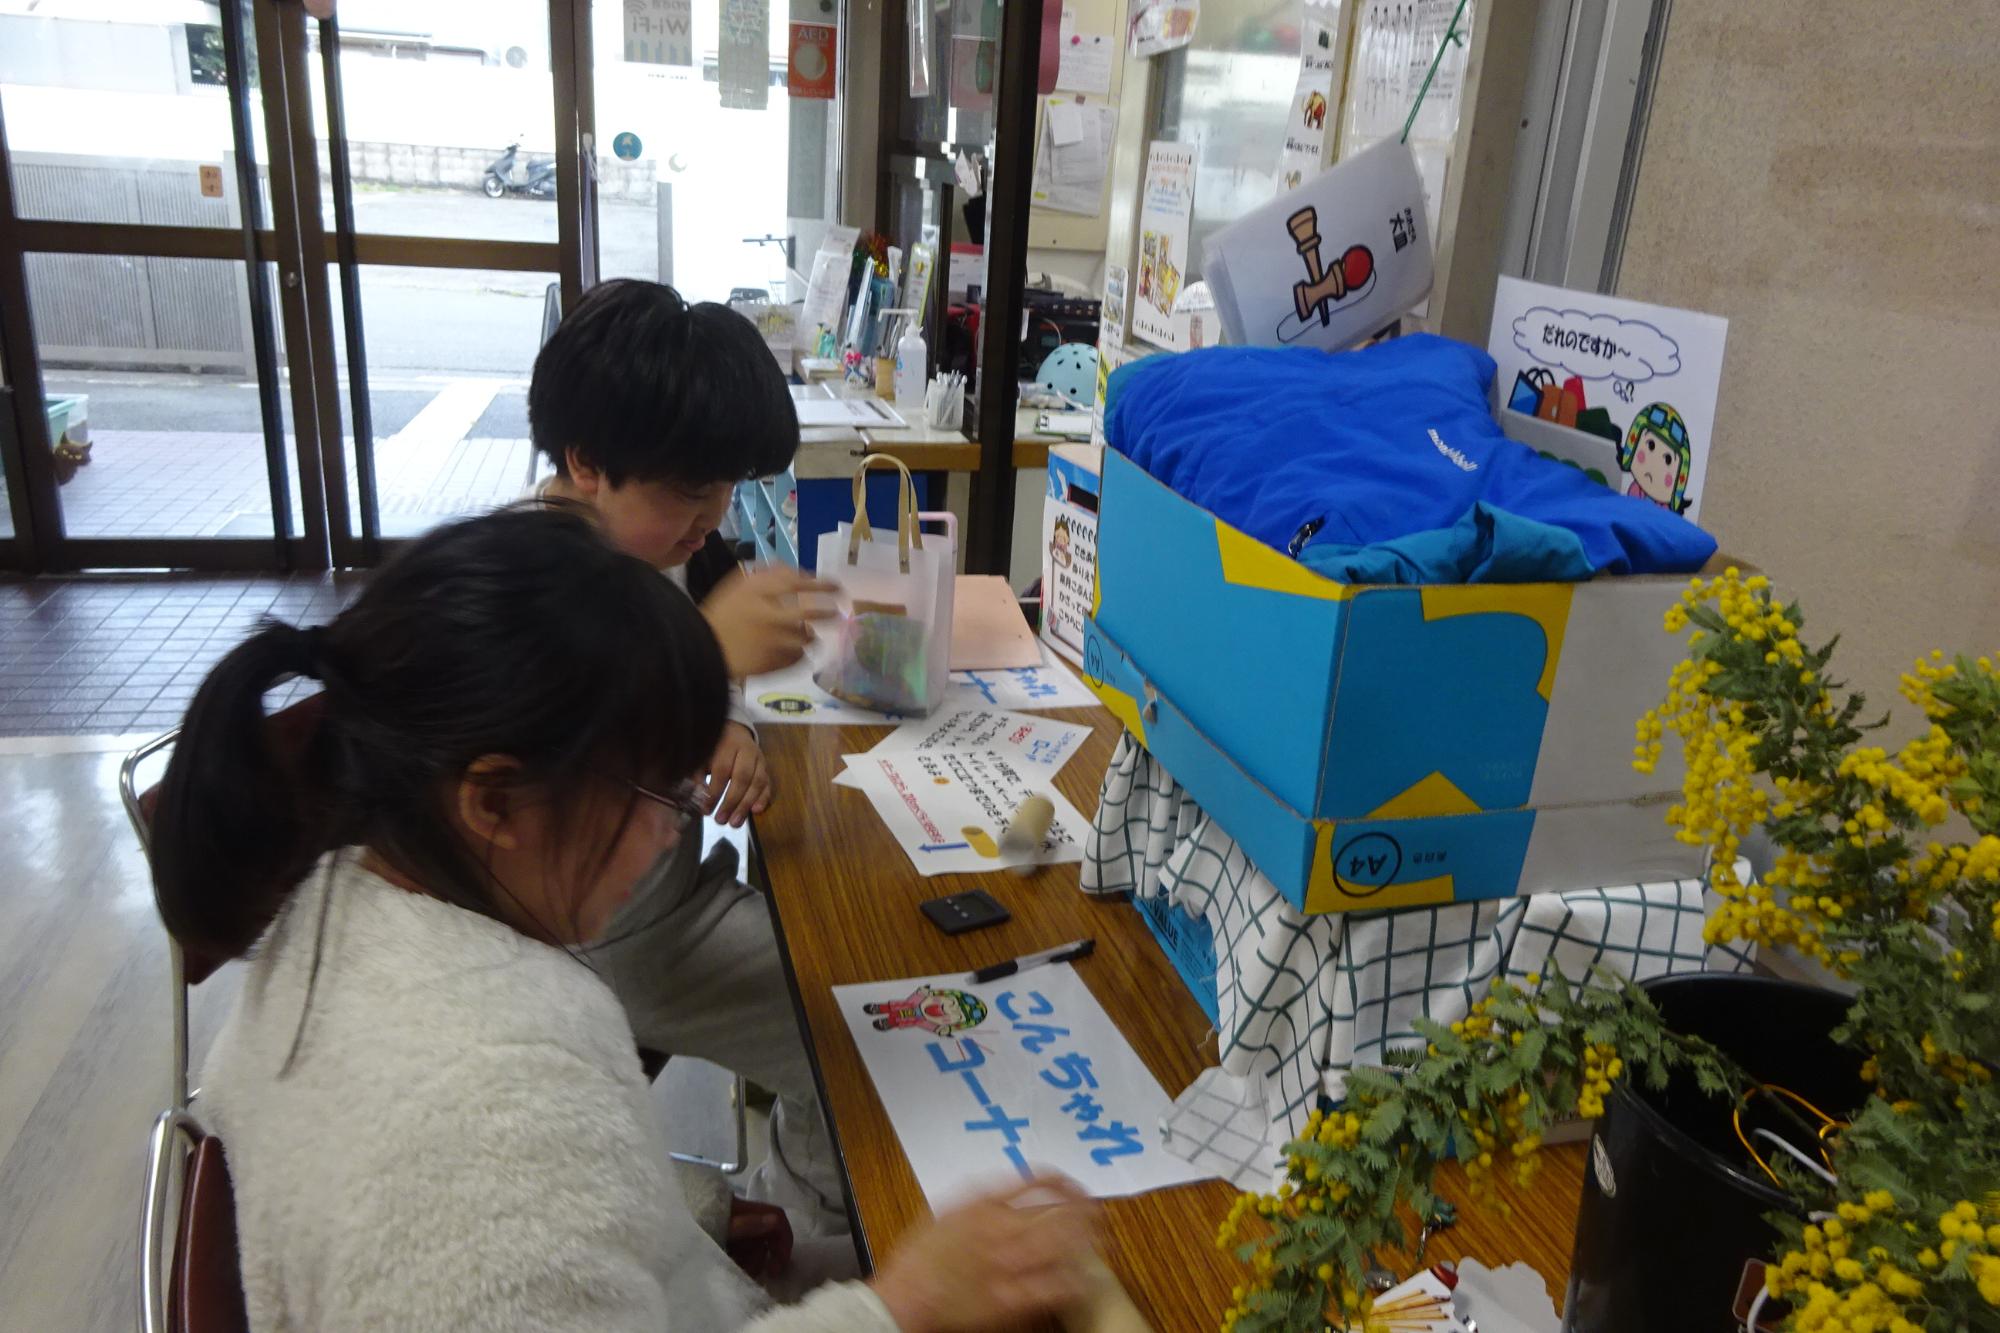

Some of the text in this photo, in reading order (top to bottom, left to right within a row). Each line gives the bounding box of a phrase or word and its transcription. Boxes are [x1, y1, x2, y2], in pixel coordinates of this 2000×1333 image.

[1350, 853, 1388, 878] A4
[925, 1036, 1036, 1185] コーナー
[995, 990, 1145, 1167] こんちゃれ
